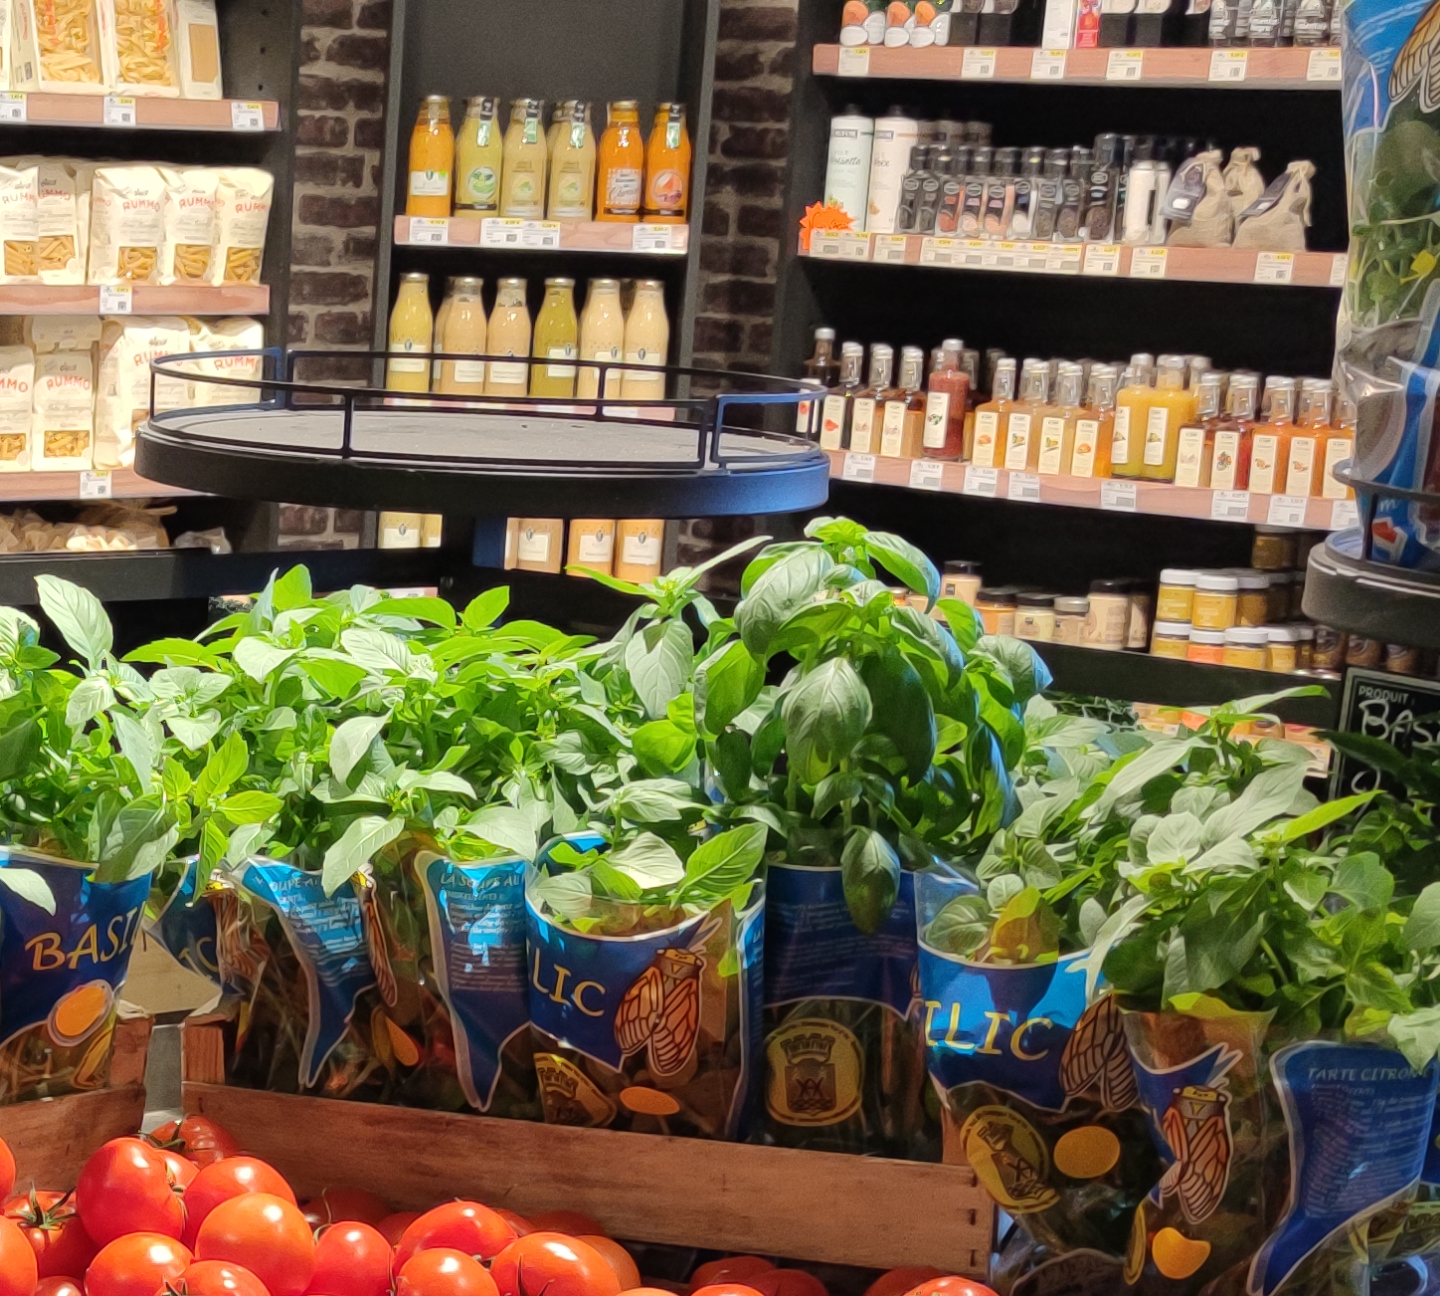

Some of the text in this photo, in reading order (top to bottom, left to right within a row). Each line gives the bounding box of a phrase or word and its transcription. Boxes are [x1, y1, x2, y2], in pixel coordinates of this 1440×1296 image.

[122, 199, 162, 213] RUMMO
[46, 375, 92, 391] RUMMO
[1358, 685, 1409, 704] PRODUIT
[1307, 1066, 1357, 1082] TARTE
